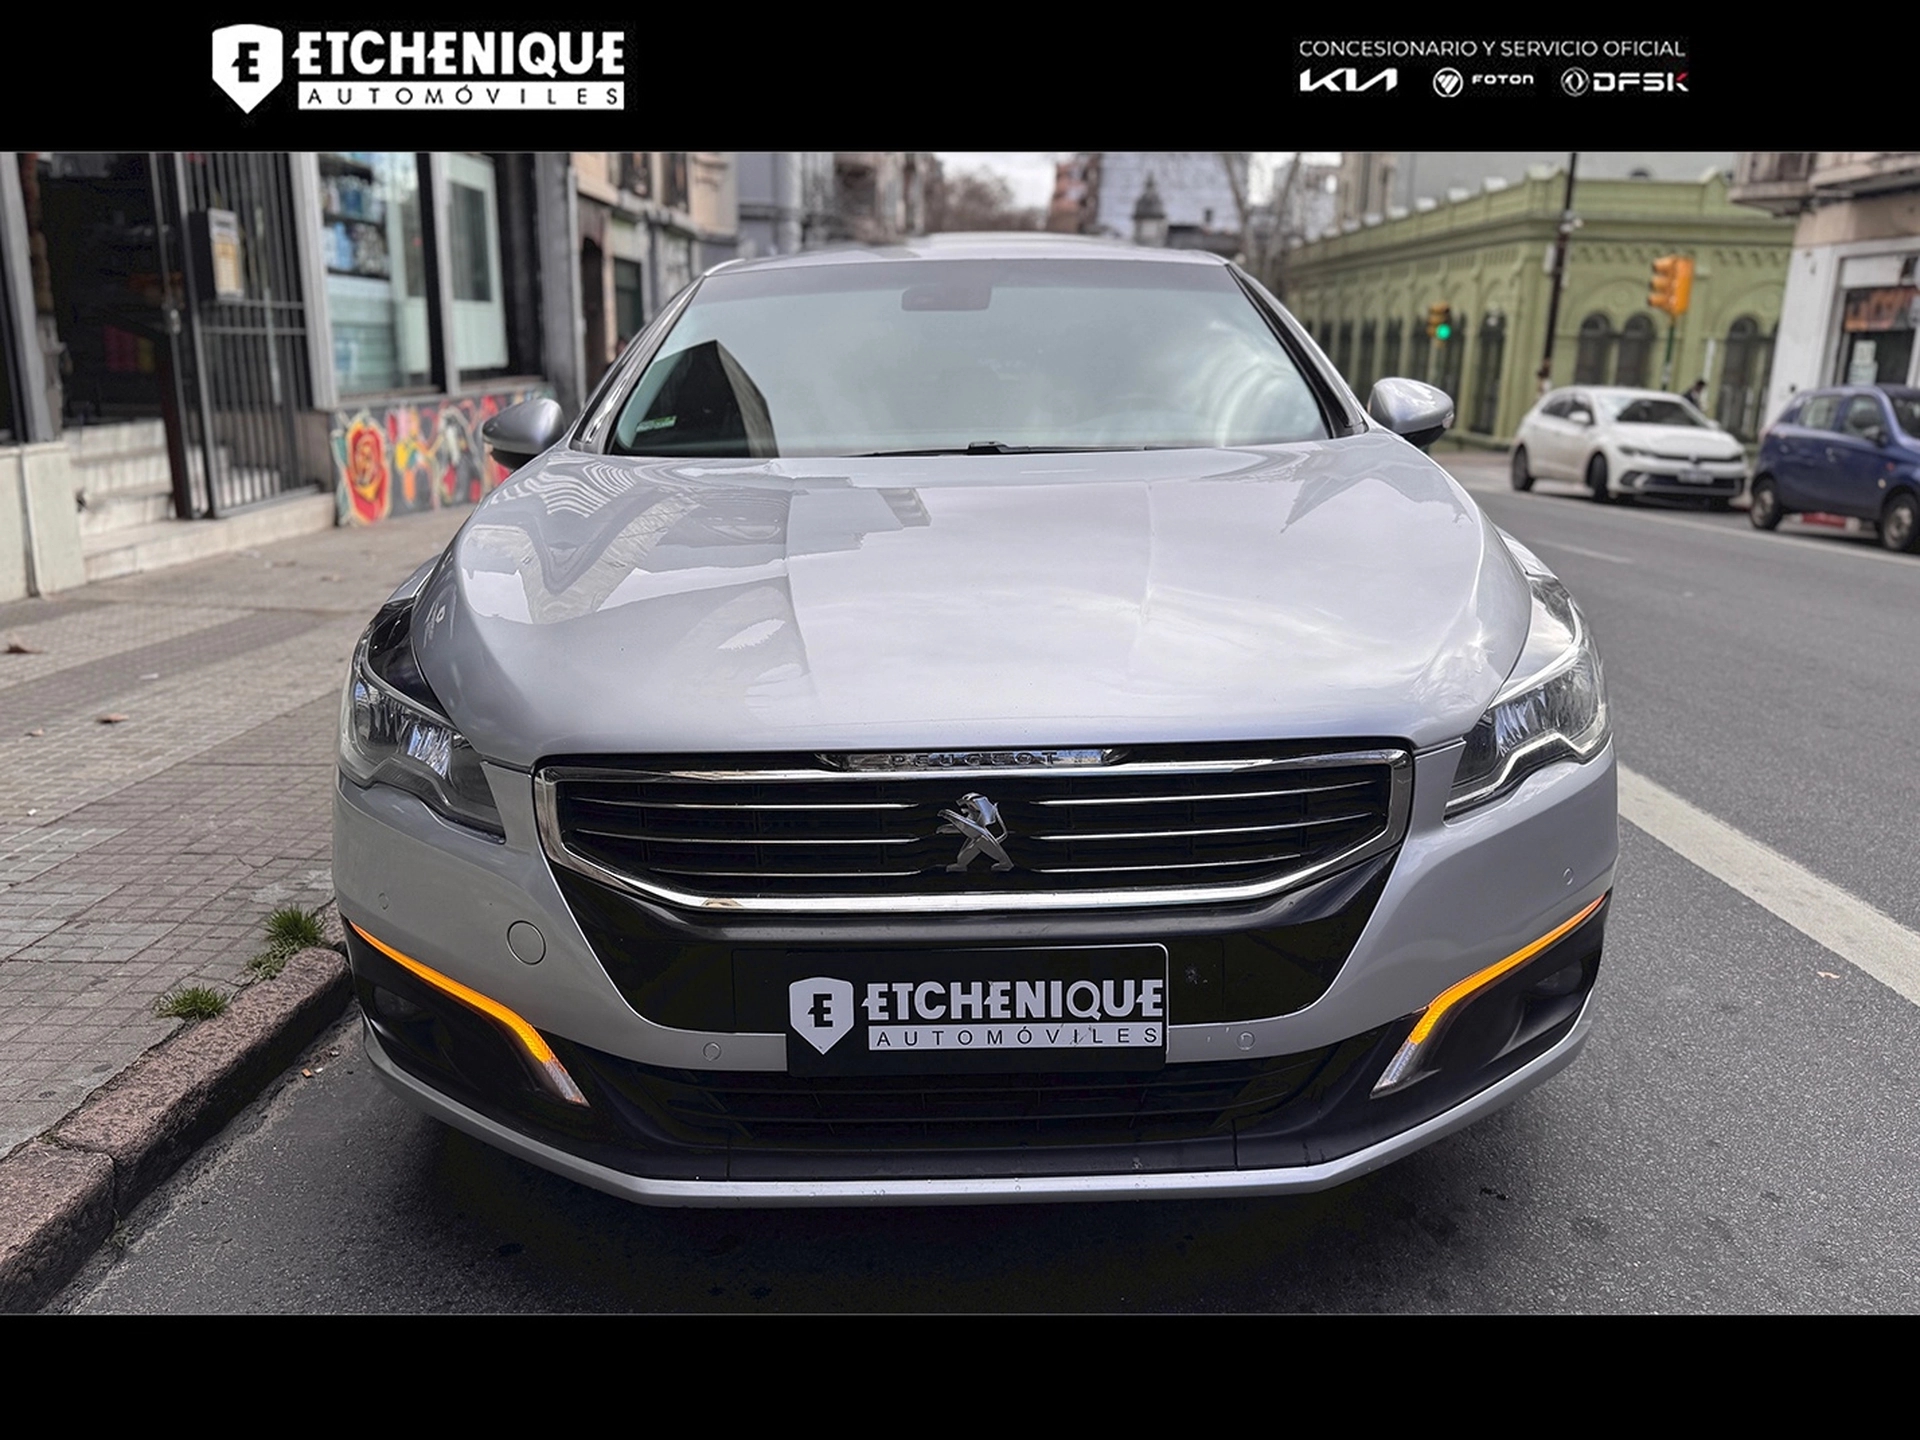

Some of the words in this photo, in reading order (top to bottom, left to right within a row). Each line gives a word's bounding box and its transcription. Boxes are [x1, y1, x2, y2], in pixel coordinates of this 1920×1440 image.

[889, 751, 1058, 769] PEUGEOT
[861, 979, 1164, 1021] ETCHENIQUE
[876, 1025, 1158, 1047] AUTOMÓVILES
